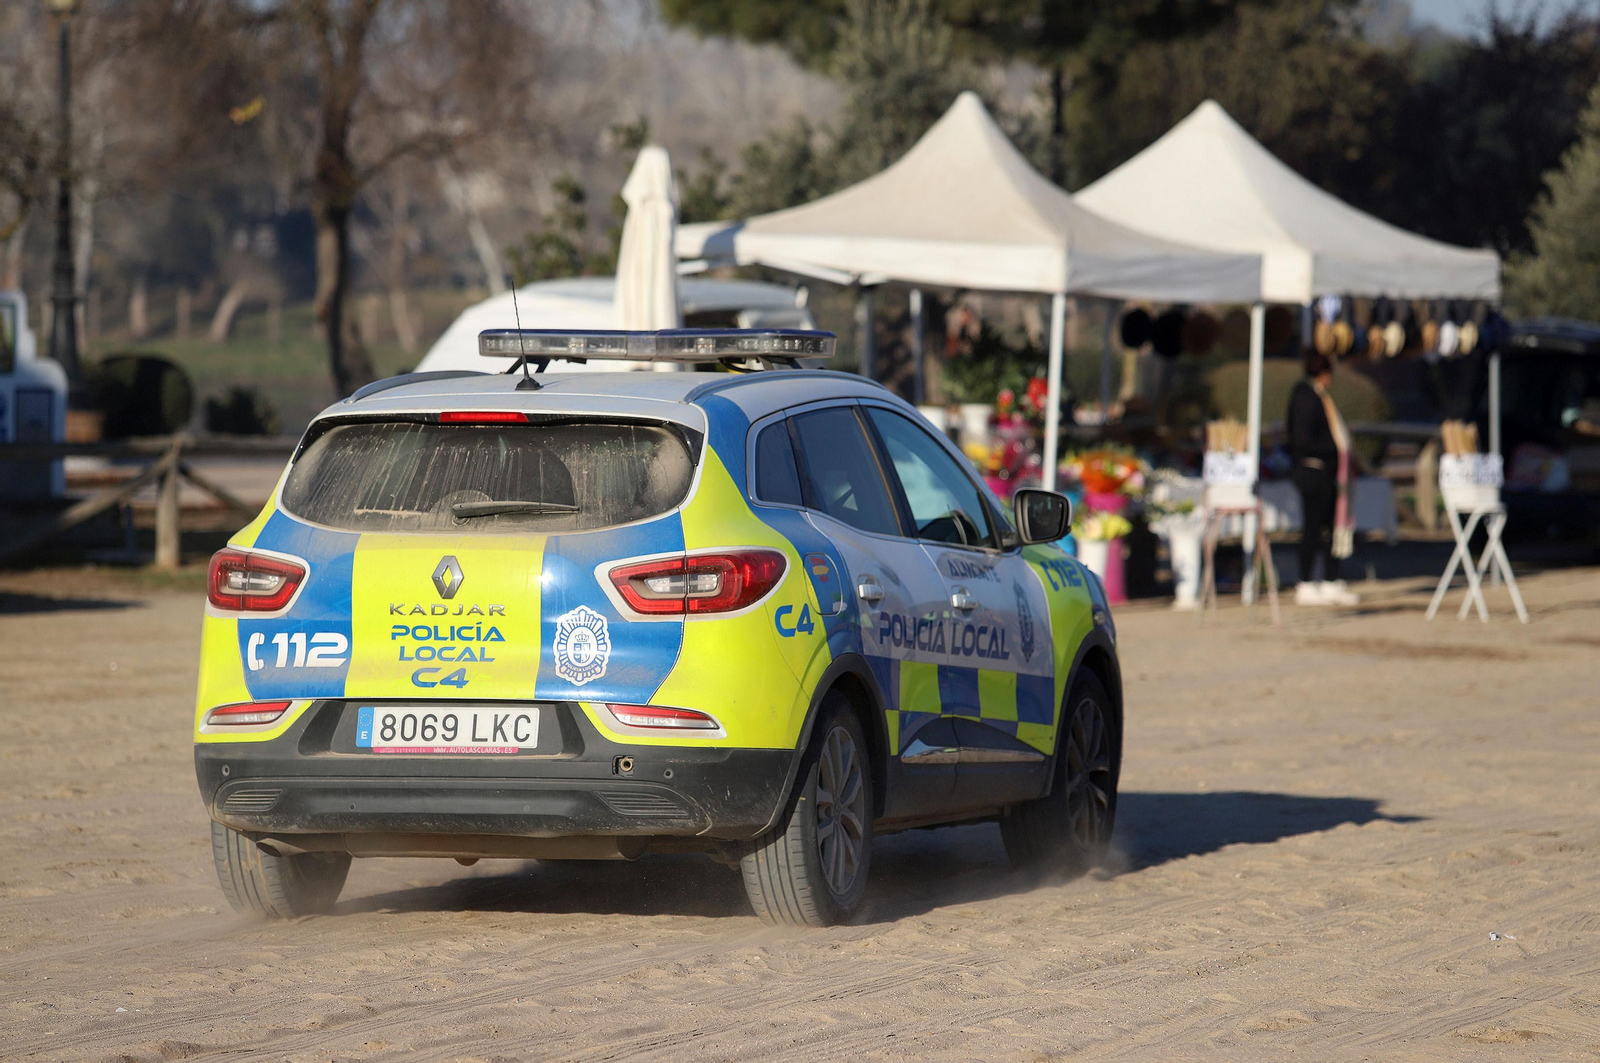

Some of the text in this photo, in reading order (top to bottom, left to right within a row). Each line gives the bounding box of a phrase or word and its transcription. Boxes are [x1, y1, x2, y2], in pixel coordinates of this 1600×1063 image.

[1051, 560, 1082, 588] 112
[389, 603, 506, 616] KADJAR
[775, 603, 815, 637] C4
[391, 622, 506, 642] POLICÍA
[879, 611, 1010, 660] POLICÍA LOCAL
[271, 632, 348, 668] 112
[399, 646, 495, 662] LOCAL
[411, 667, 470, 688] C4
[361, 731, 368, 740] E
[380, 713, 532, 742] 8069 LKC
[433, 746, 513, 754] WWW.AUTOLASCLARAS.ES
